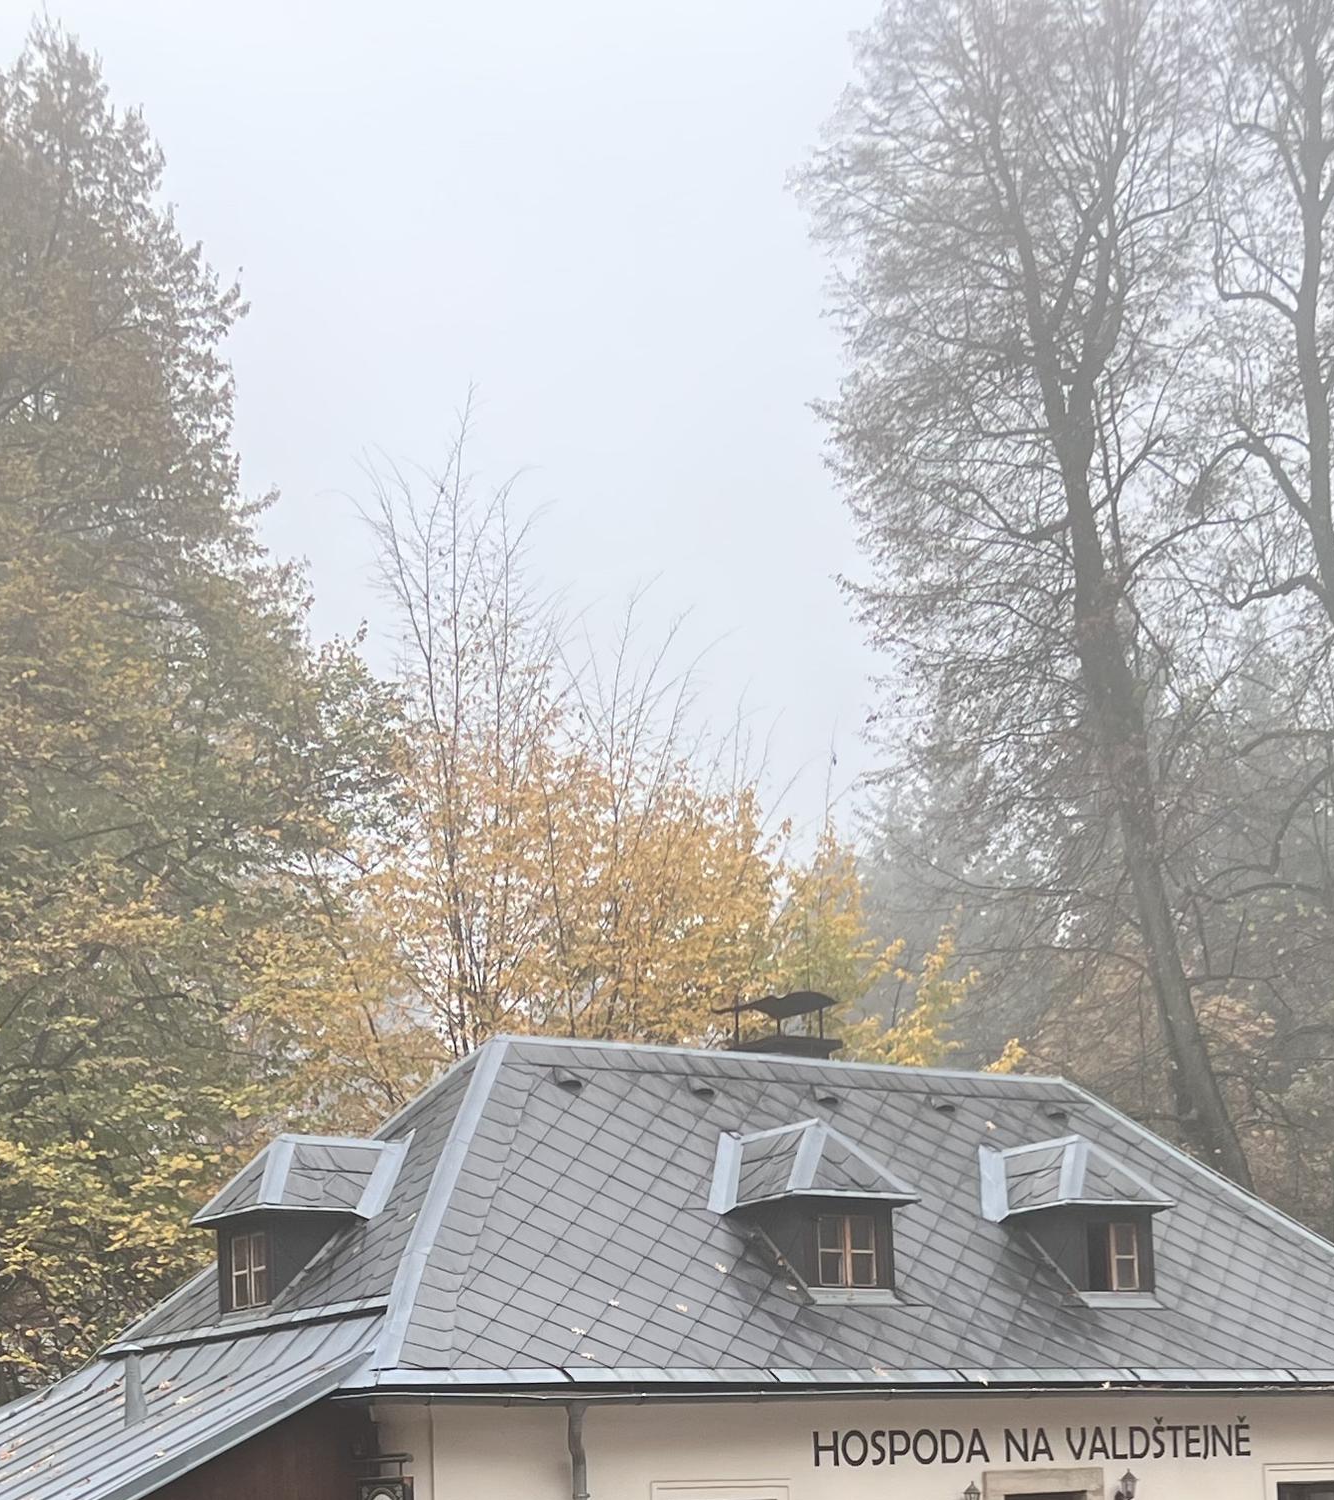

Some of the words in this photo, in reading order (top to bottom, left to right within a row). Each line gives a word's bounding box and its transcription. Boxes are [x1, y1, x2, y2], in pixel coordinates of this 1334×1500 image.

[812, 1428, 990, 1467] HOSPODA
[1004, 1427, 1055, 1462] NA
[1066, 1416, 1252, 1460] VALDŠTEJNĚ
